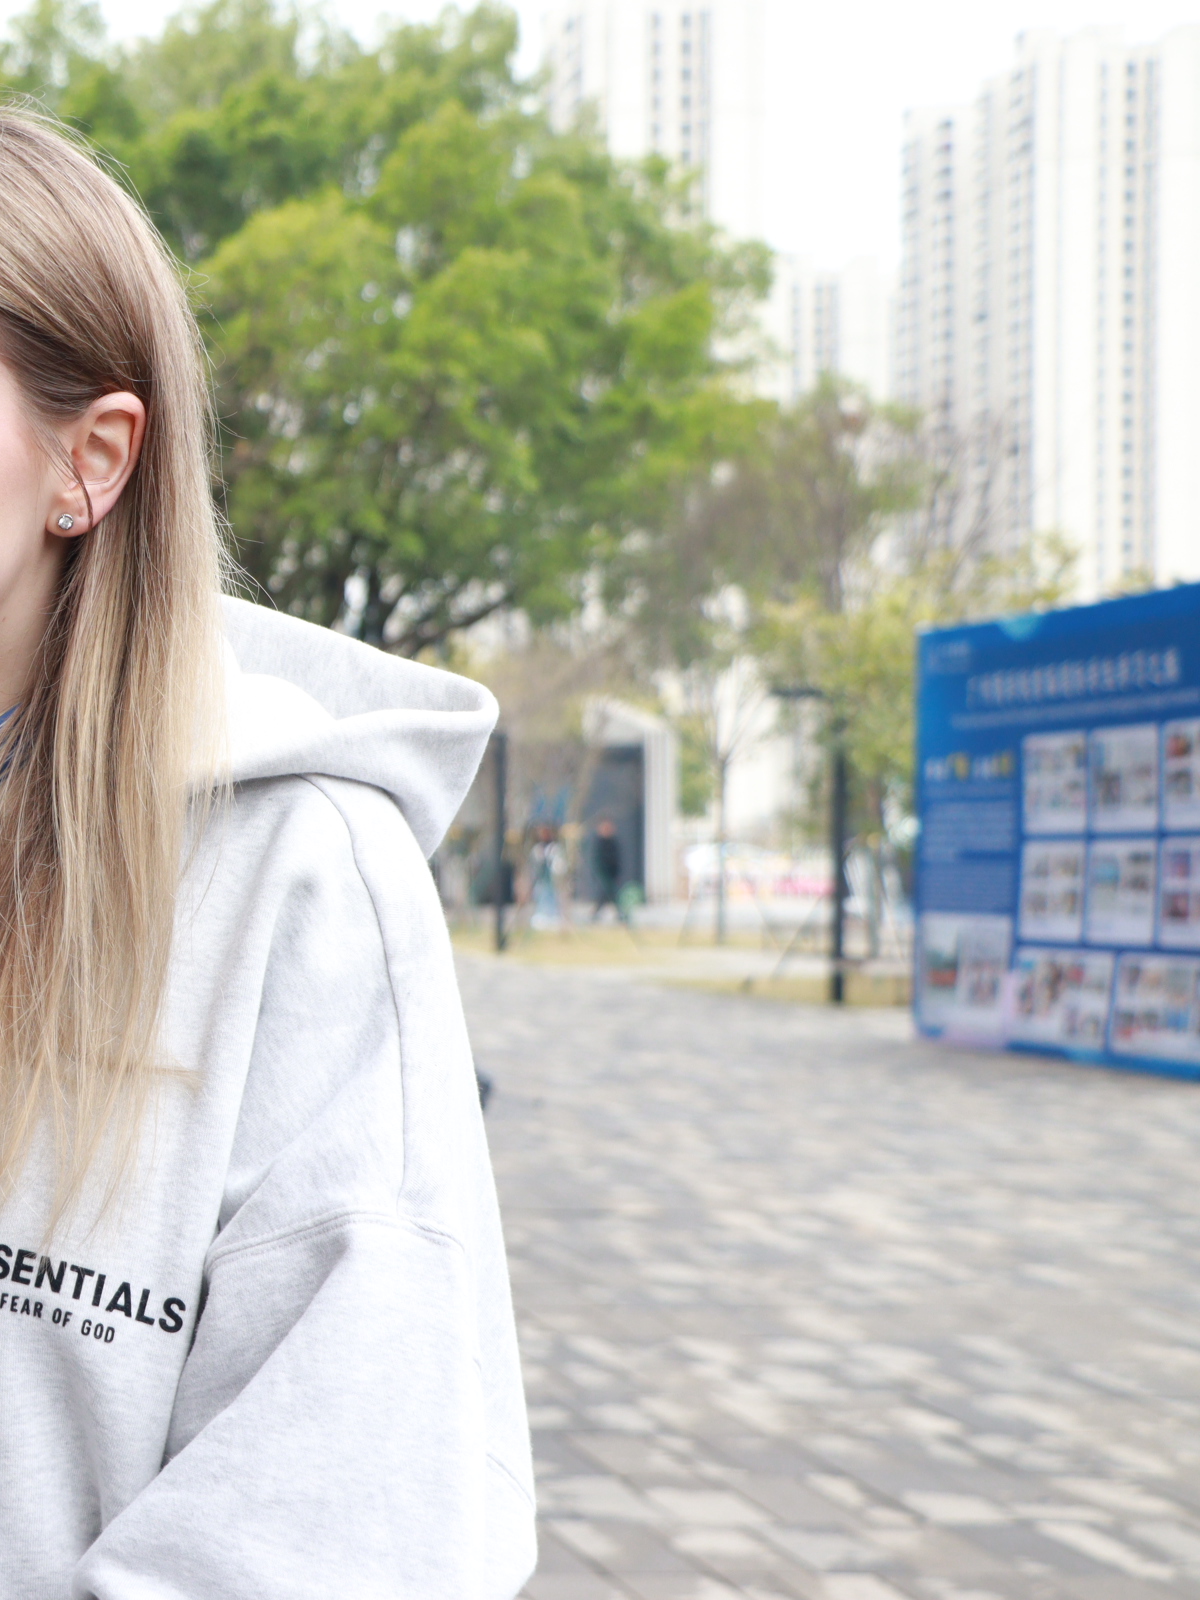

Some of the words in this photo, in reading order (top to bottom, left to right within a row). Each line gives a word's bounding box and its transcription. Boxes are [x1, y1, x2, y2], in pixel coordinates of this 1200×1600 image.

[0, 1292, 43, 1318] FEAR
[51, 1307, 73, 1328] OF
[80, 1318, 116, 1344] GOD
